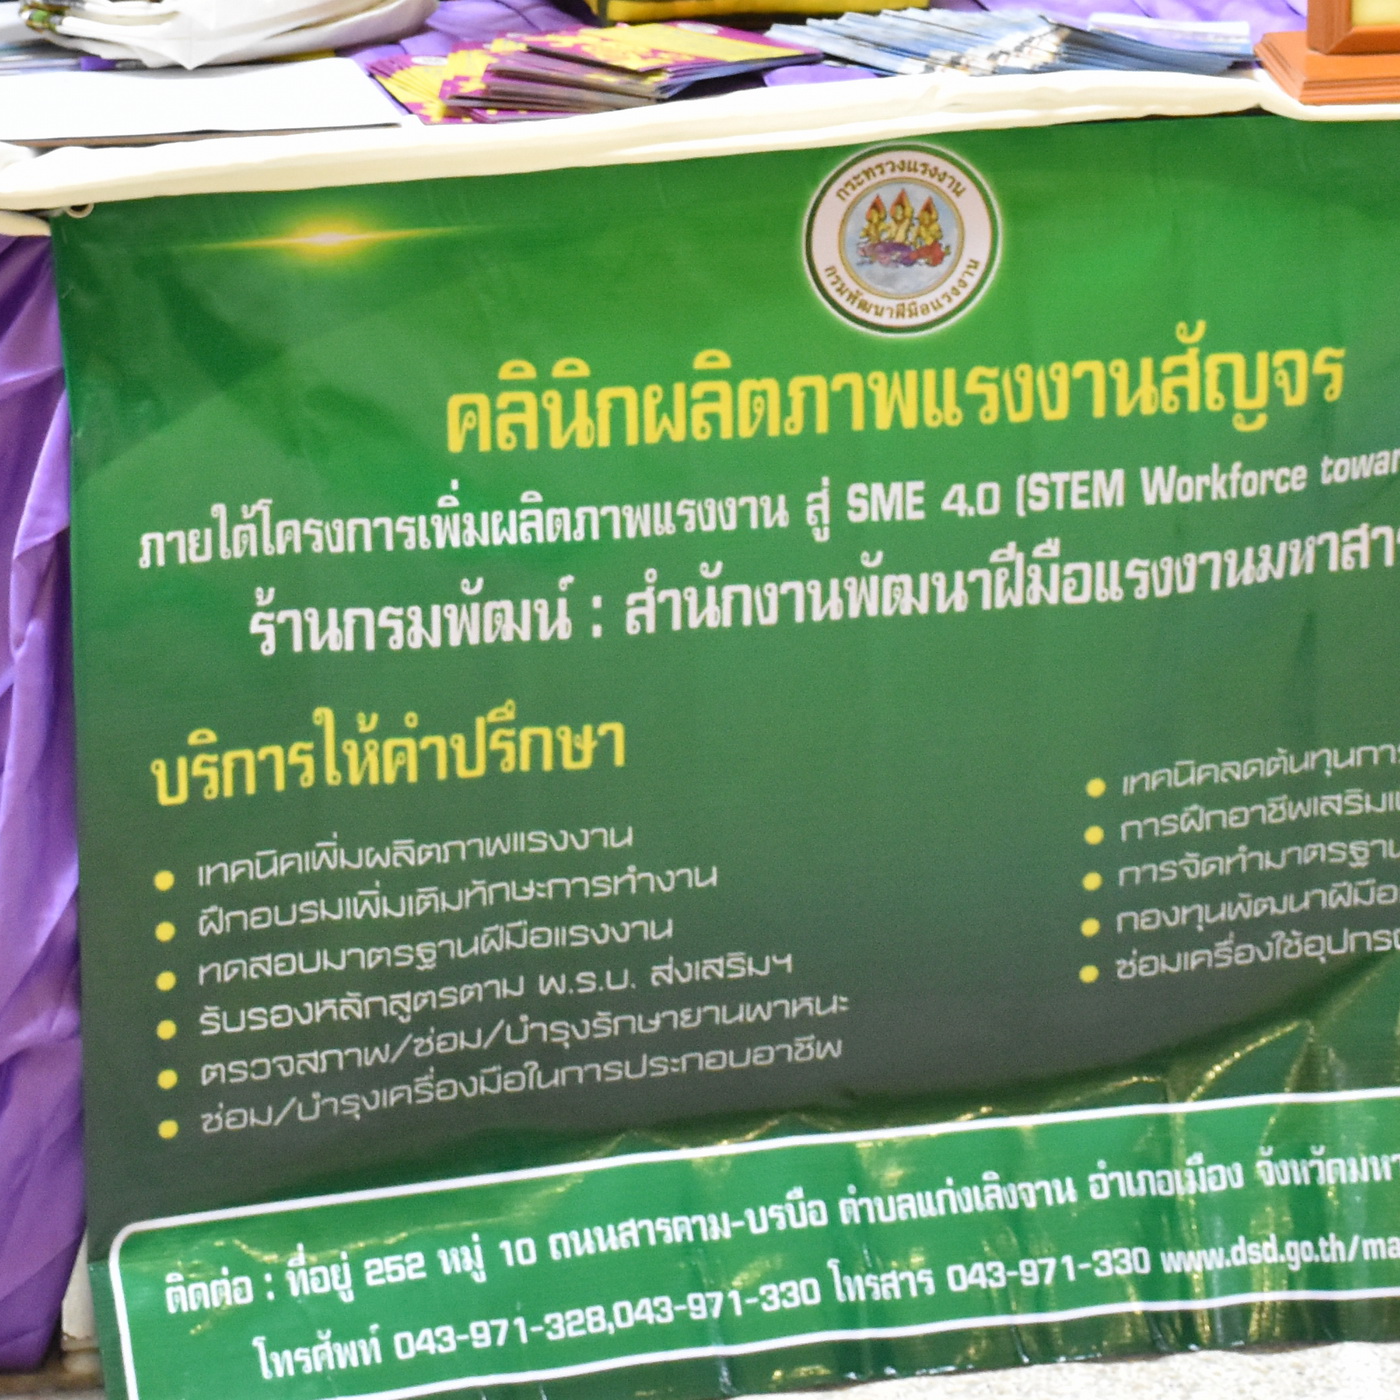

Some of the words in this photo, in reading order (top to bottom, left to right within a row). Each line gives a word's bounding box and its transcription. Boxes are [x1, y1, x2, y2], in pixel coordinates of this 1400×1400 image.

[834, 157, 968, 202] กระทรวงแรงงาน
[823, 257, 982, 321] กรมพัฒนาฝีมือแรงงาน
[447, 319, 1345, 454] คลินิกผลิตภาพแรงงานสัญจร
[137, 478, 790, 569] ภายใต้โครงการเพิ่มผลิตภาพแรงงาน
[804, 476, 832, 543] สู่
[847, 480, 926, 523] SME
[940, 481, 1001, 517] 4.0
[1139, 461, 1308, 506] Workforce
[249, 574, 575, 656] ร้านกรมพัฒน์
[150, 699, 625, 806] บริการให้คำปรึกษา
[198, 826, 633, 887] เทคนิคเพิ่มผลิตภาพแรงงาน
[198, 864, 718, 937] ฝึกอบรมเพิ่มเติมทักษะการทำงาน
[198, 918, 673, 986] ทดสอบมาตรฐานฝีมือแรงงาน
[199, 975, 525, 1036] รับรองหลักสูตรตาม
[538, 968, 638, 996] พ.ร.บ.
[650, 951, 792, 987] ส่งเสริมฯ
[200, 994, 849, 1086] ตรวจสภาพ/ซ่อม/บำรุงรักษายานพาหนะ
[200, 1034, 843, 1134] ซ่อม/บำรุงเครื่องมือในการประกอบอาชีพ
[165, 1266, 254, 1314] ติดต่อ
[285, 1250, 355, 1303] ที่อยู่
[363, 1251, 427, 1287] 252
[437, 1232, 487, 1284] หมู่
[499, 1237, 537, 1267] 10
[548, 1186, 829, 1261] ถนนสารคาม-บรบือ
[838, 1171, 1078, 1225] ตำบลแก่งเลิงจาน
[1088, 1152, 1245, 1201] อำเภอเมือง
[251, 1323, 383, 1380] โทรศัพท์
[393, 1277, 822, 1361] 043-971-328,043-971-330
[826, 1256, 936, 1303] โทรสาร
[946, 1246, 1151, 1293] 043-971-330
